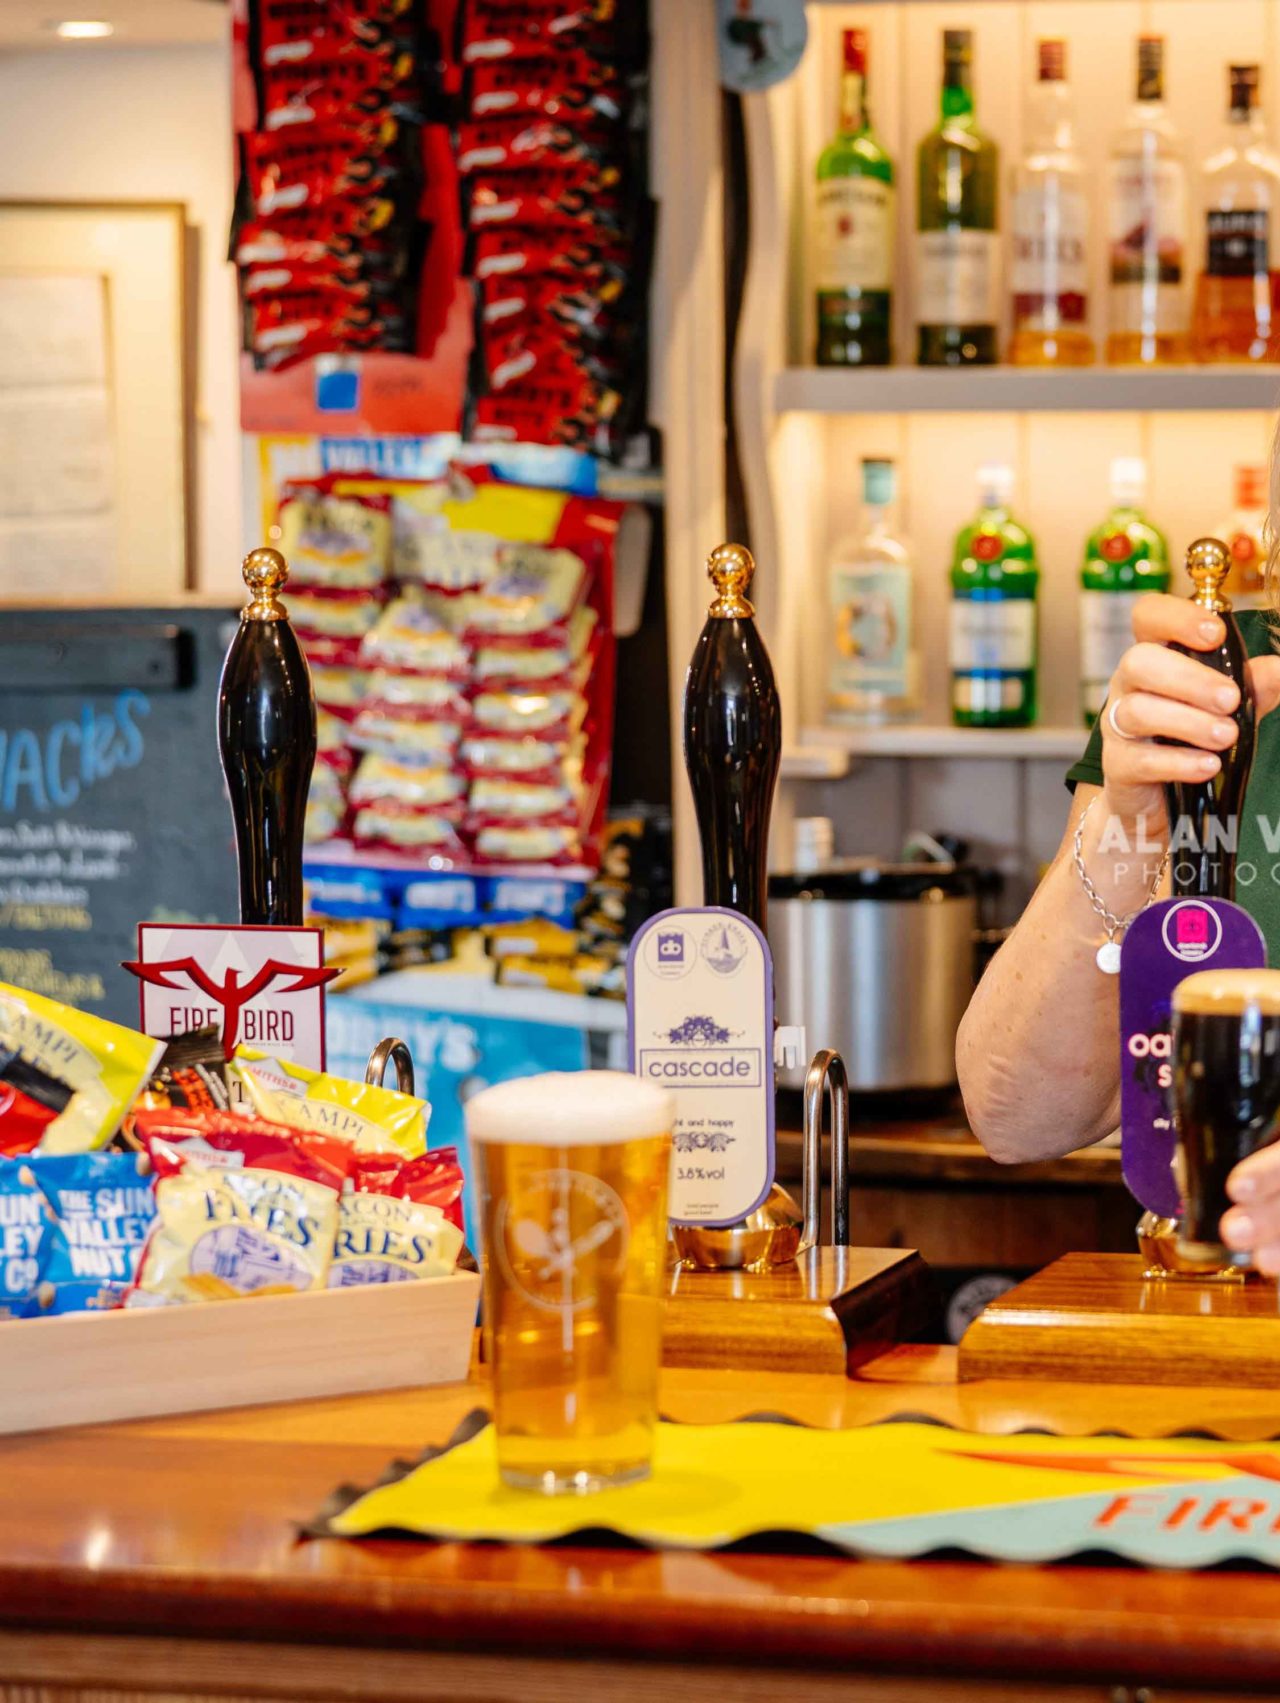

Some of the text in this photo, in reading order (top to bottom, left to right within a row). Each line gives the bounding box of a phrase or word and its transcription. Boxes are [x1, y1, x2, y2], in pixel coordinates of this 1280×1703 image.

[244, 1010, 295, 1042] BIRD
[648, 1055, 752, 1078] cascade
[0, 1193, 41, 1227] UN
[333, 1228, 433, 1263] RIES
